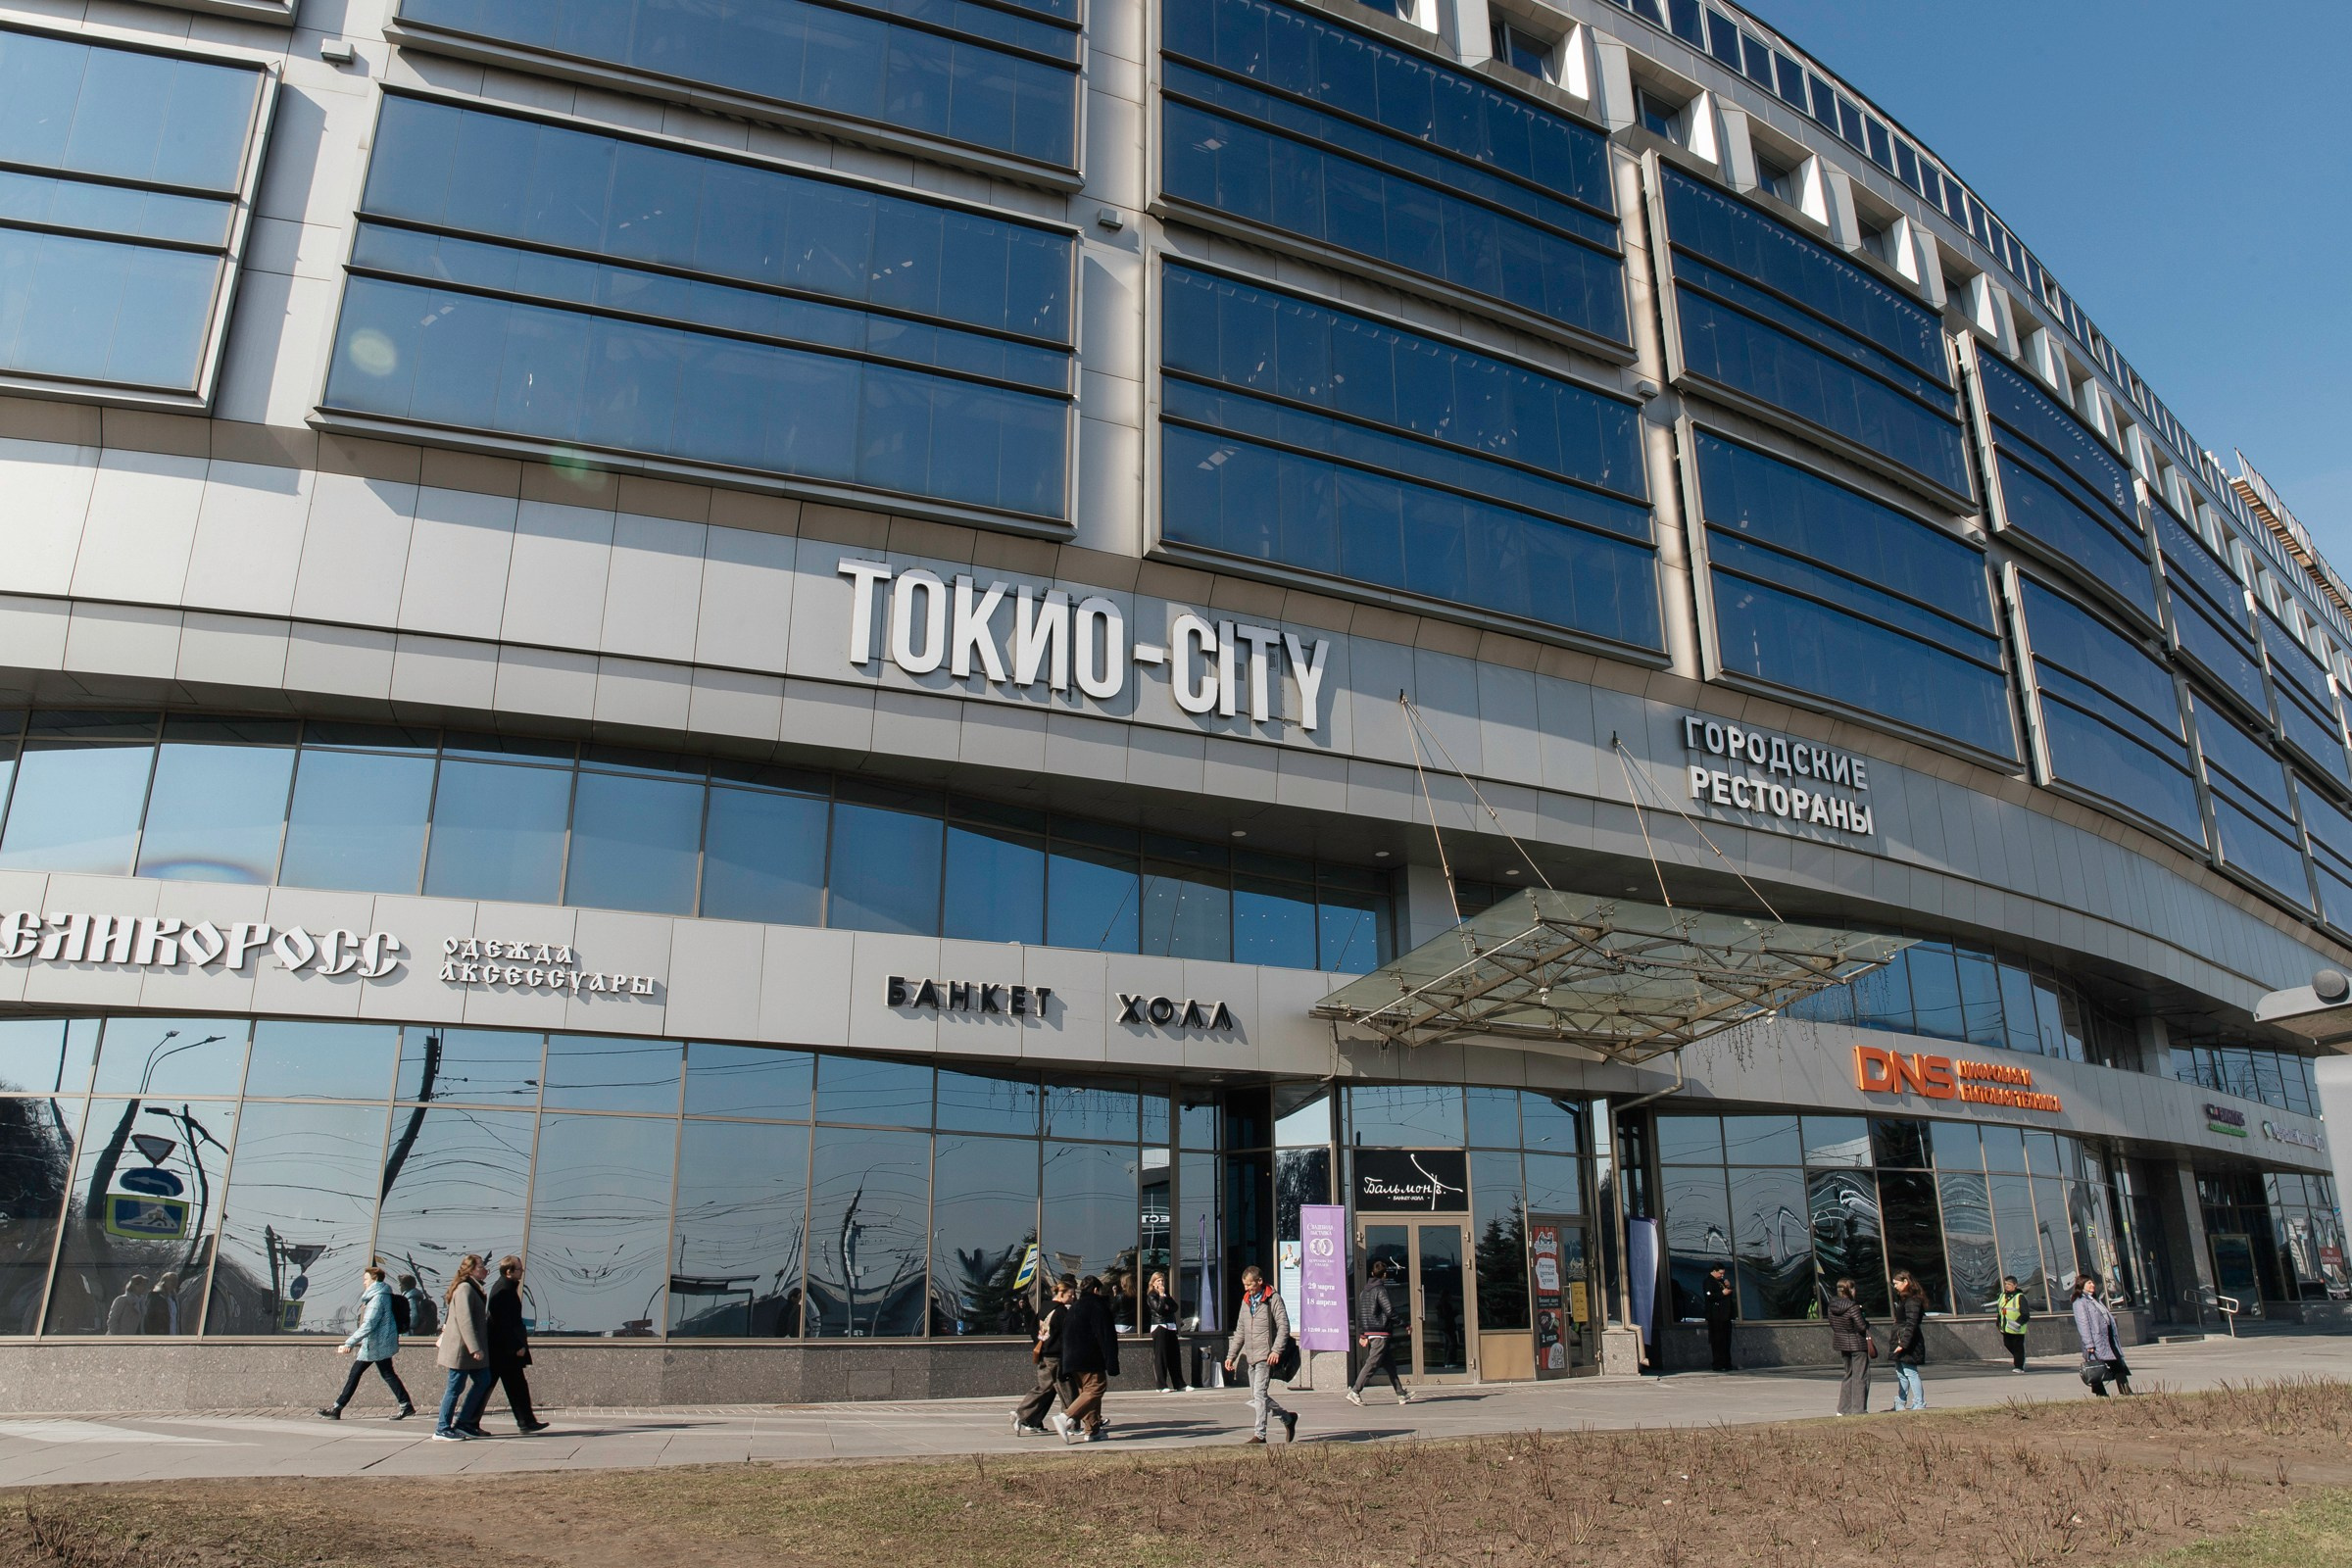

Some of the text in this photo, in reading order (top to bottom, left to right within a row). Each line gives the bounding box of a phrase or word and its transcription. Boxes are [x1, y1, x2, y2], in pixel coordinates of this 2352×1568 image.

[1684, 715, 1868, 790] ГОРОДСКИЕ
[1688, 765, 1874, 835] РЕСТОРАНЫ
[443, 936, 573, 965] ОДЕЖДА
[439, 961, 656, 995] АКСЕССУАРЫ
[885, 975, 1235, 1031] БАНКЕТ ХОЛЛ
[1854, 1045, 1956, 1100] DNS
[1956, 1059, 2033, 1087] ЦИФРОВАЯ И
[1959, 1083, 2063, 1112] БЫТОВАЯ ТЕХНИКА
